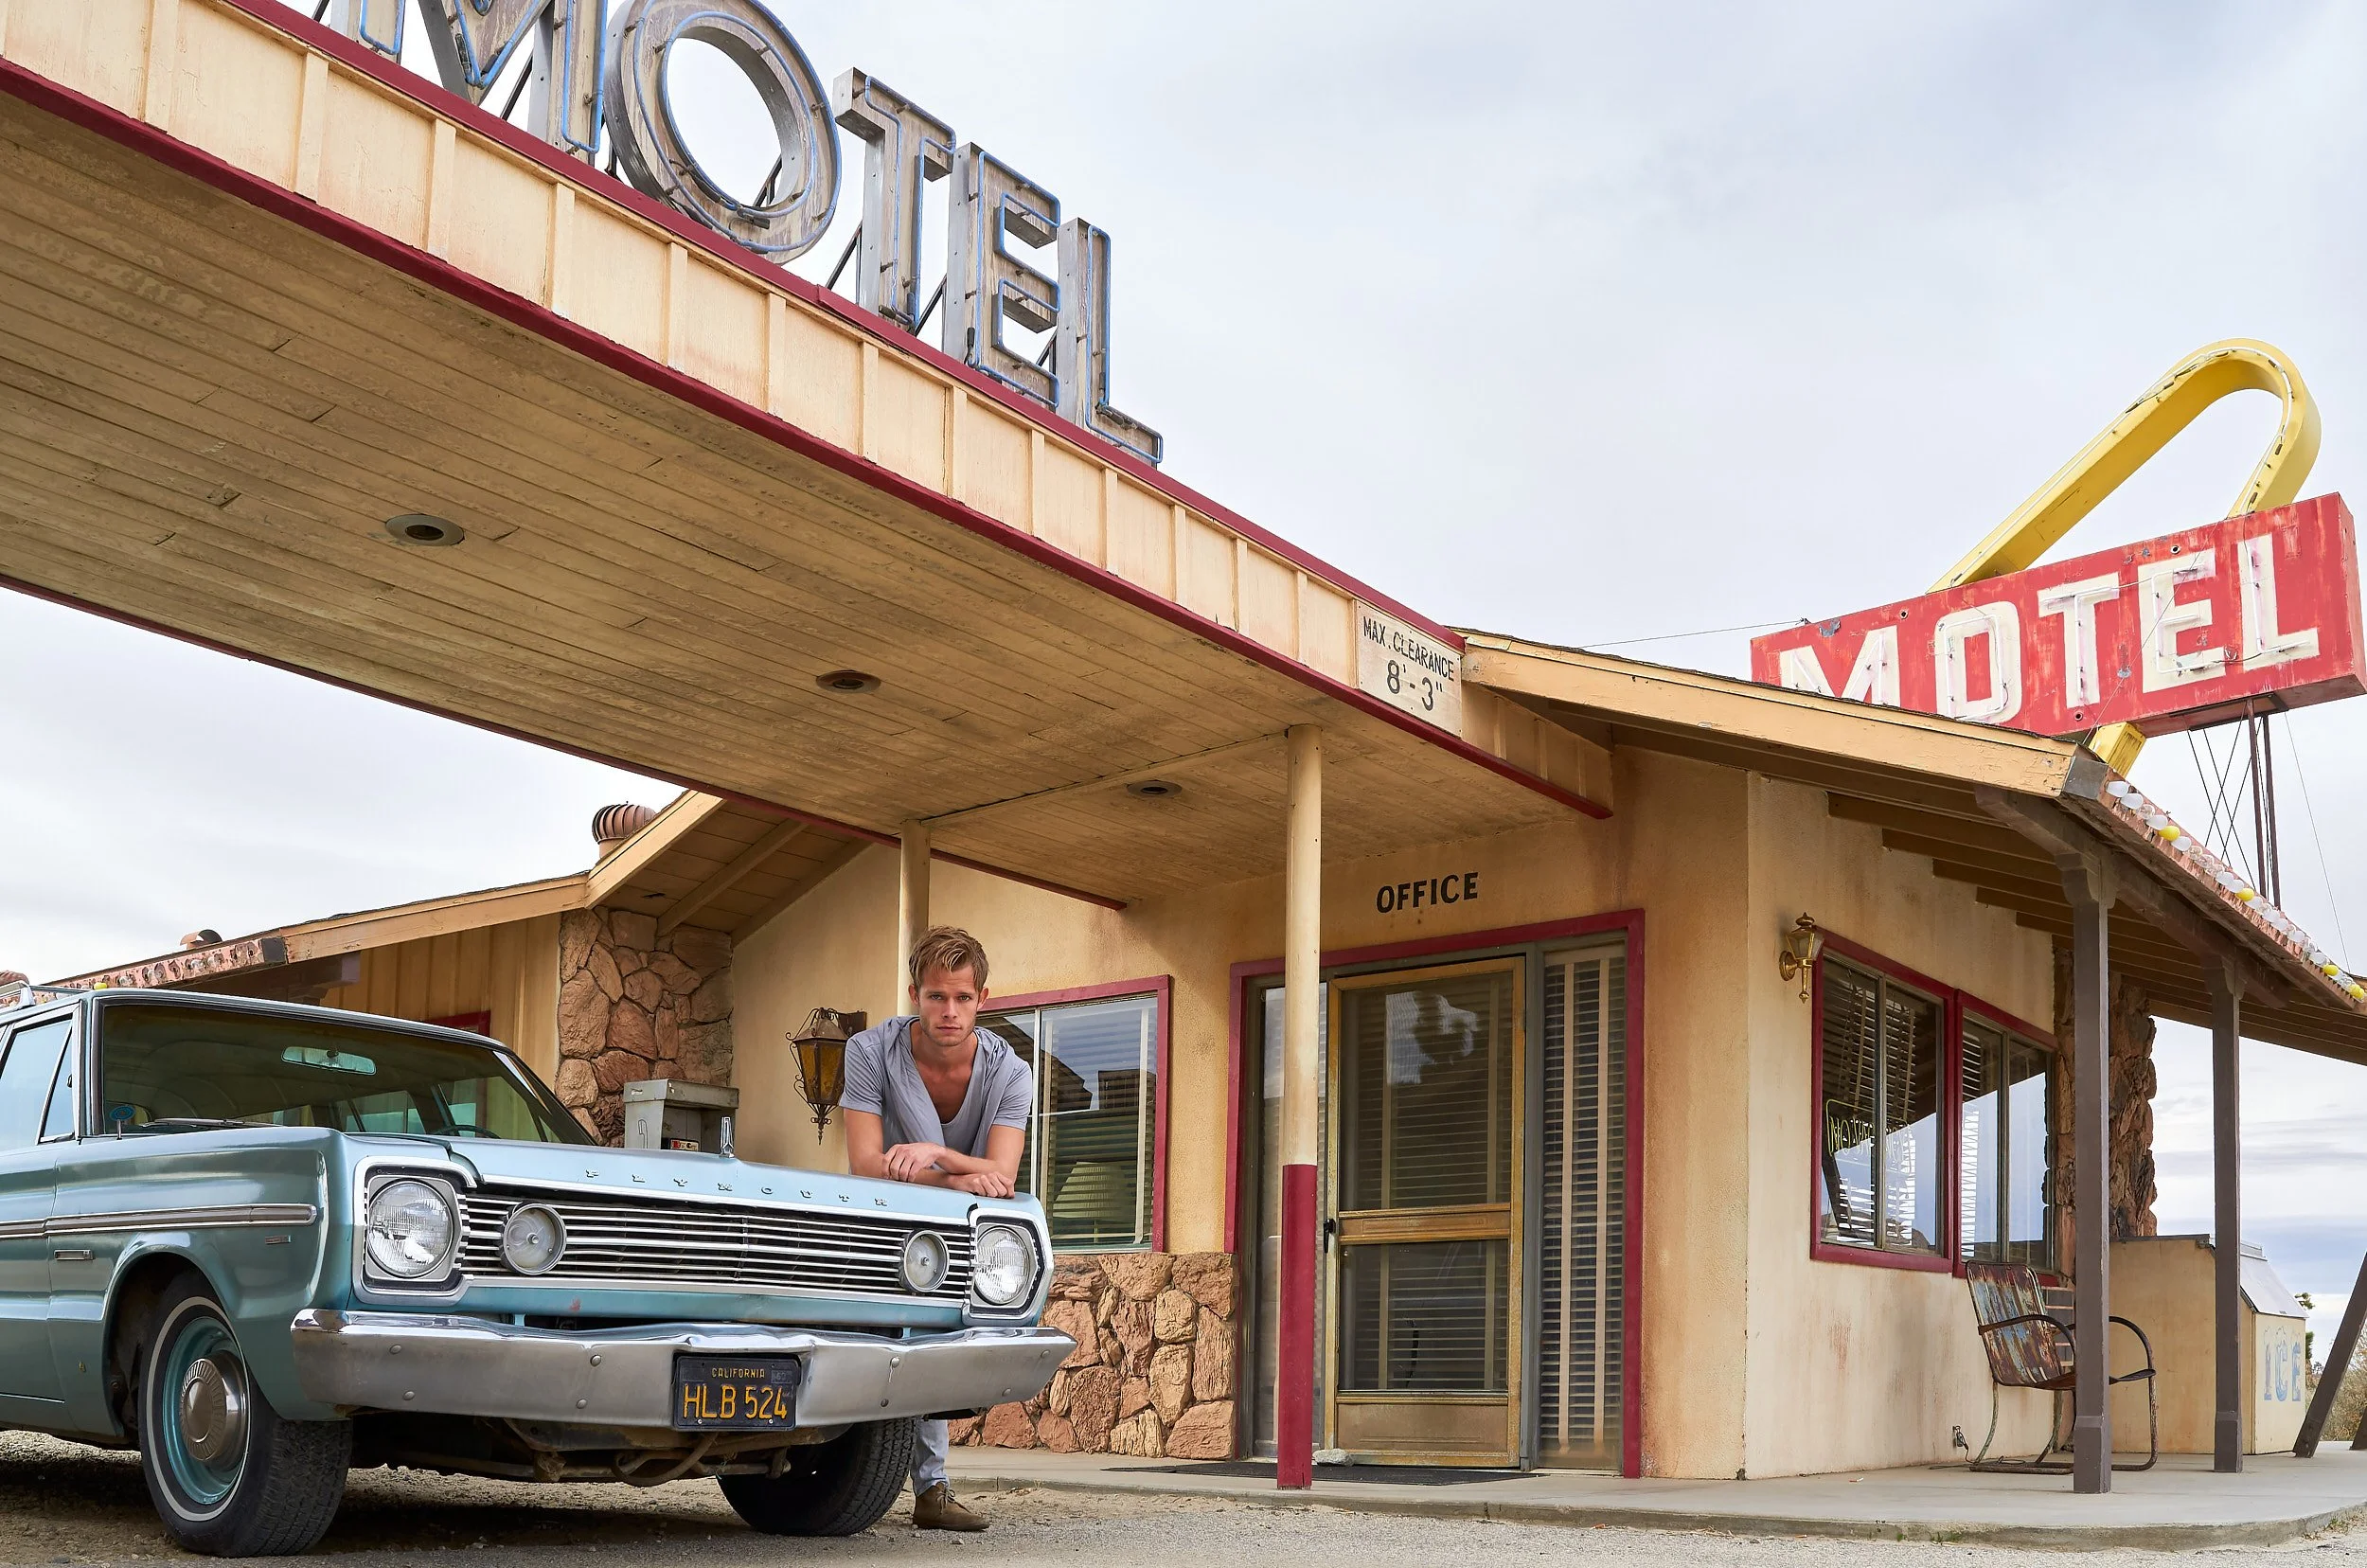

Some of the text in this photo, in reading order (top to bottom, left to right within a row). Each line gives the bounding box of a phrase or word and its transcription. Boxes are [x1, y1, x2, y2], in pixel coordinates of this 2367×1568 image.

[1363, 615, 1454, 682] MAX. CLEARANCE
[1376, 872, 1478, 913] OFFICE
[585, 1168, 888, 1207] PLYMOUTH
[711, 1367, 765, 1379] CALIFORNIA
[2264, 1331, 2301, 1401] ICE
[683, 1383, 788, 1419] HLB 524
